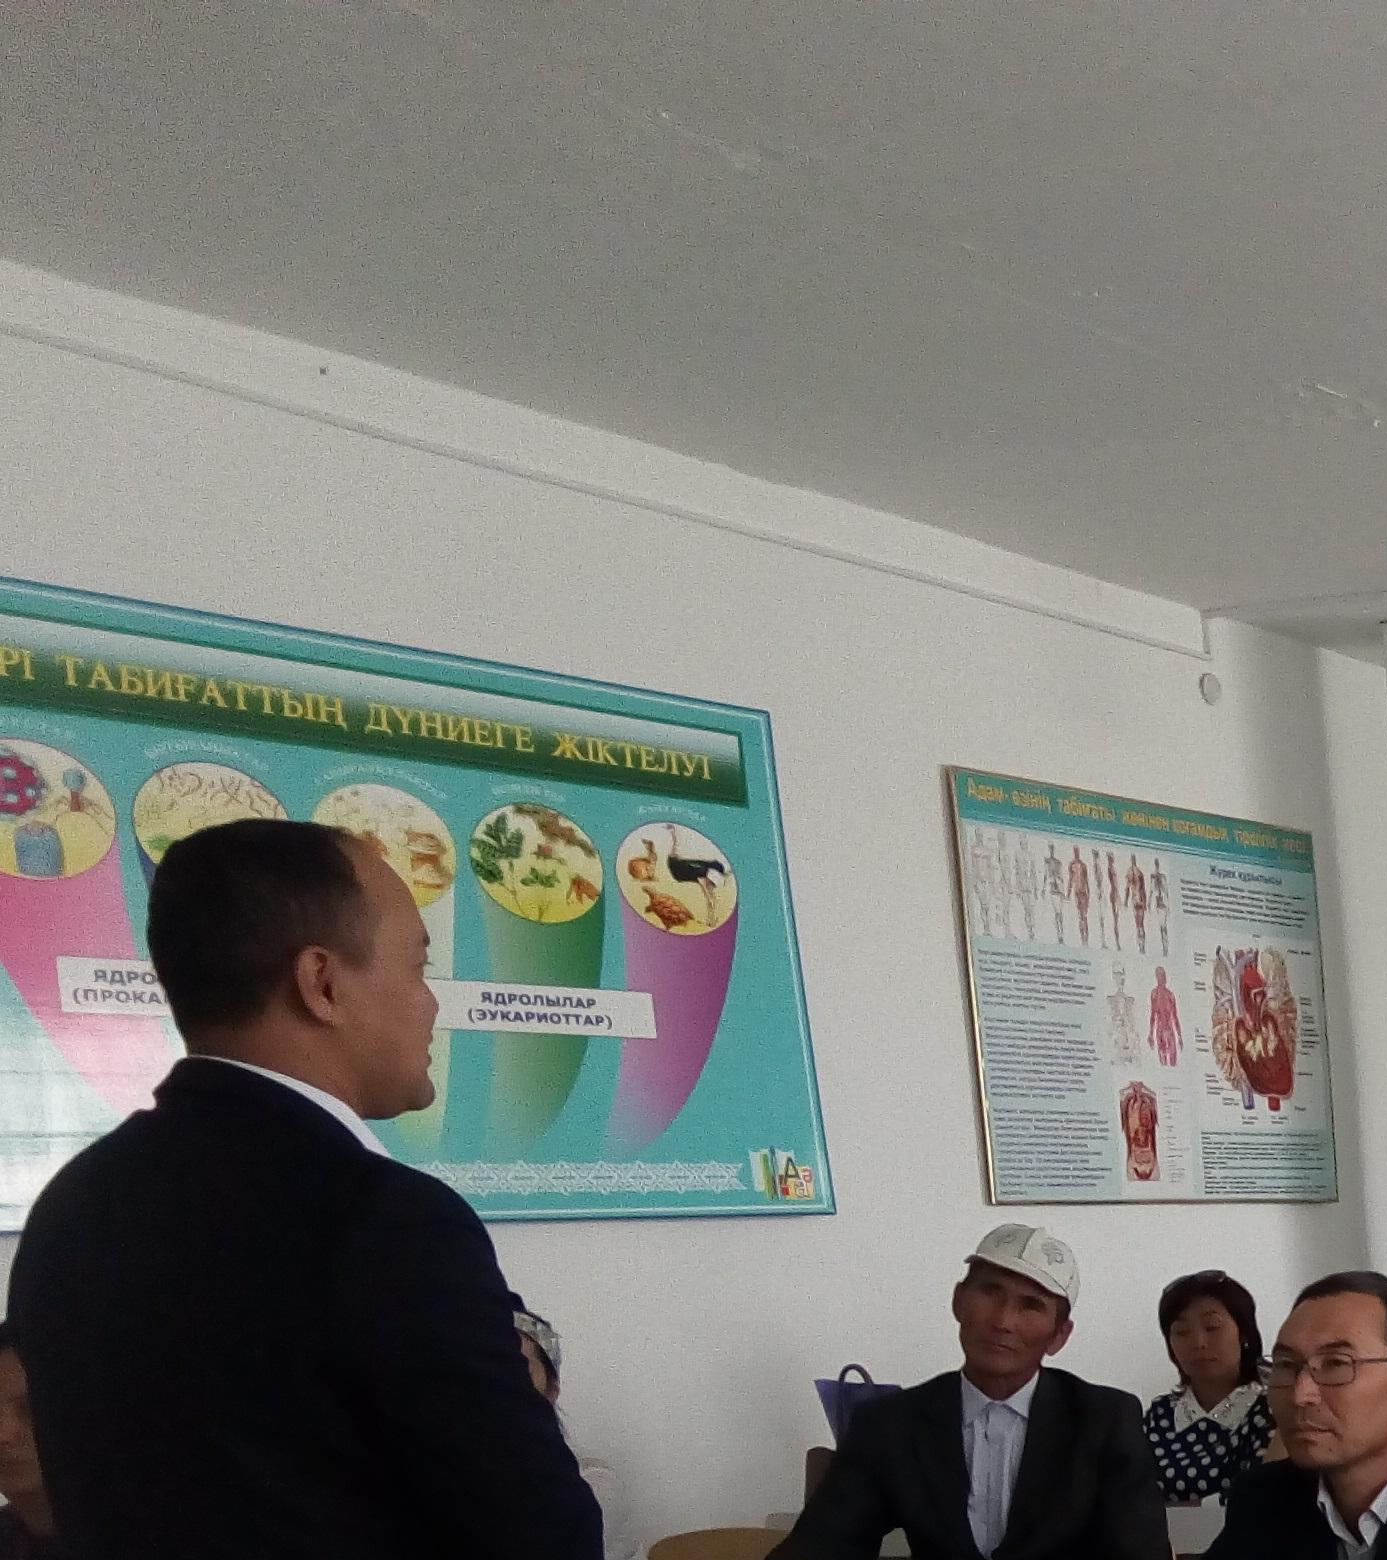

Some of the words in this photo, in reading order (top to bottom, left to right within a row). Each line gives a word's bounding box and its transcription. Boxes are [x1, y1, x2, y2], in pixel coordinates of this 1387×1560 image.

[56, 653, 348, 731] ТАБИҒАТТЫҢ
[365, 702, 535, 752] ДҮНИЕГЕ
[552, 731, 713, 781] ЖІКТЕЛУІ
[481, 991, 597, 1009] ЯДРОЛЫЛАР
[467, 1009, 613, 1030] (ЭУКАРИОТТАР)
